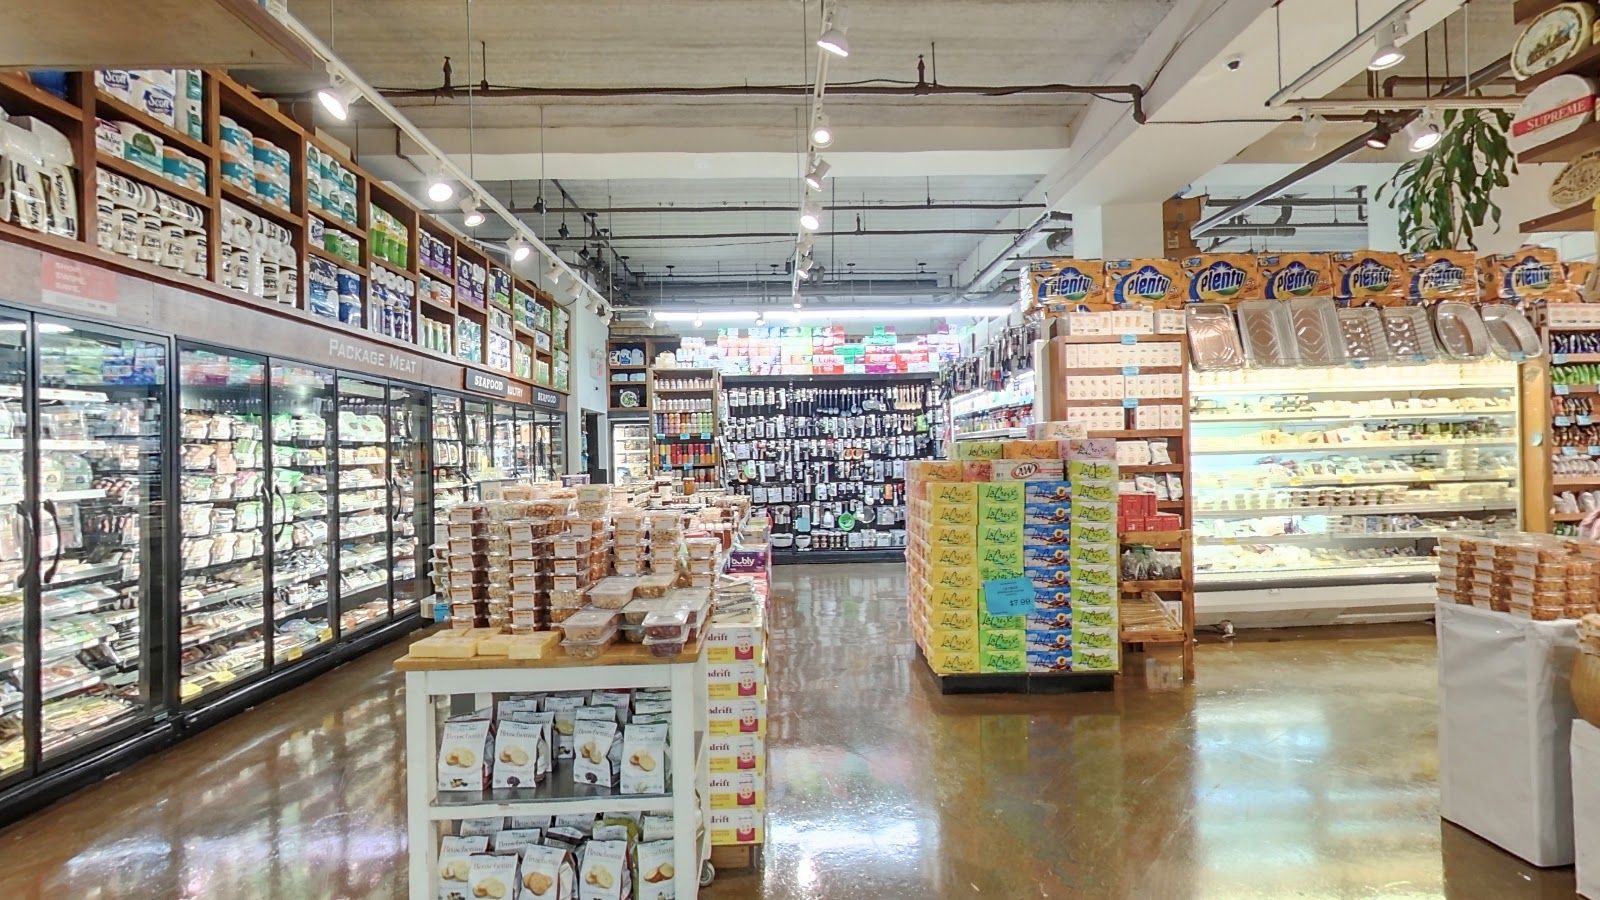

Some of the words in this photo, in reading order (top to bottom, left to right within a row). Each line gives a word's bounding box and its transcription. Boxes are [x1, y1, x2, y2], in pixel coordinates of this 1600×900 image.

[105, 70, 127, 86] Scott
[149, 95, 170, 109] Scott
[1526, 101, 1586, 131] SUPREME
[329, 339, 385, 366] PACKAGE
[389, 354, 417, 373] MEAT
[474, 376, 504, 391] SEAFOOD
[538, 392, 557, 404] SEAFOOD
[731, 557, 755, 567] bubly
